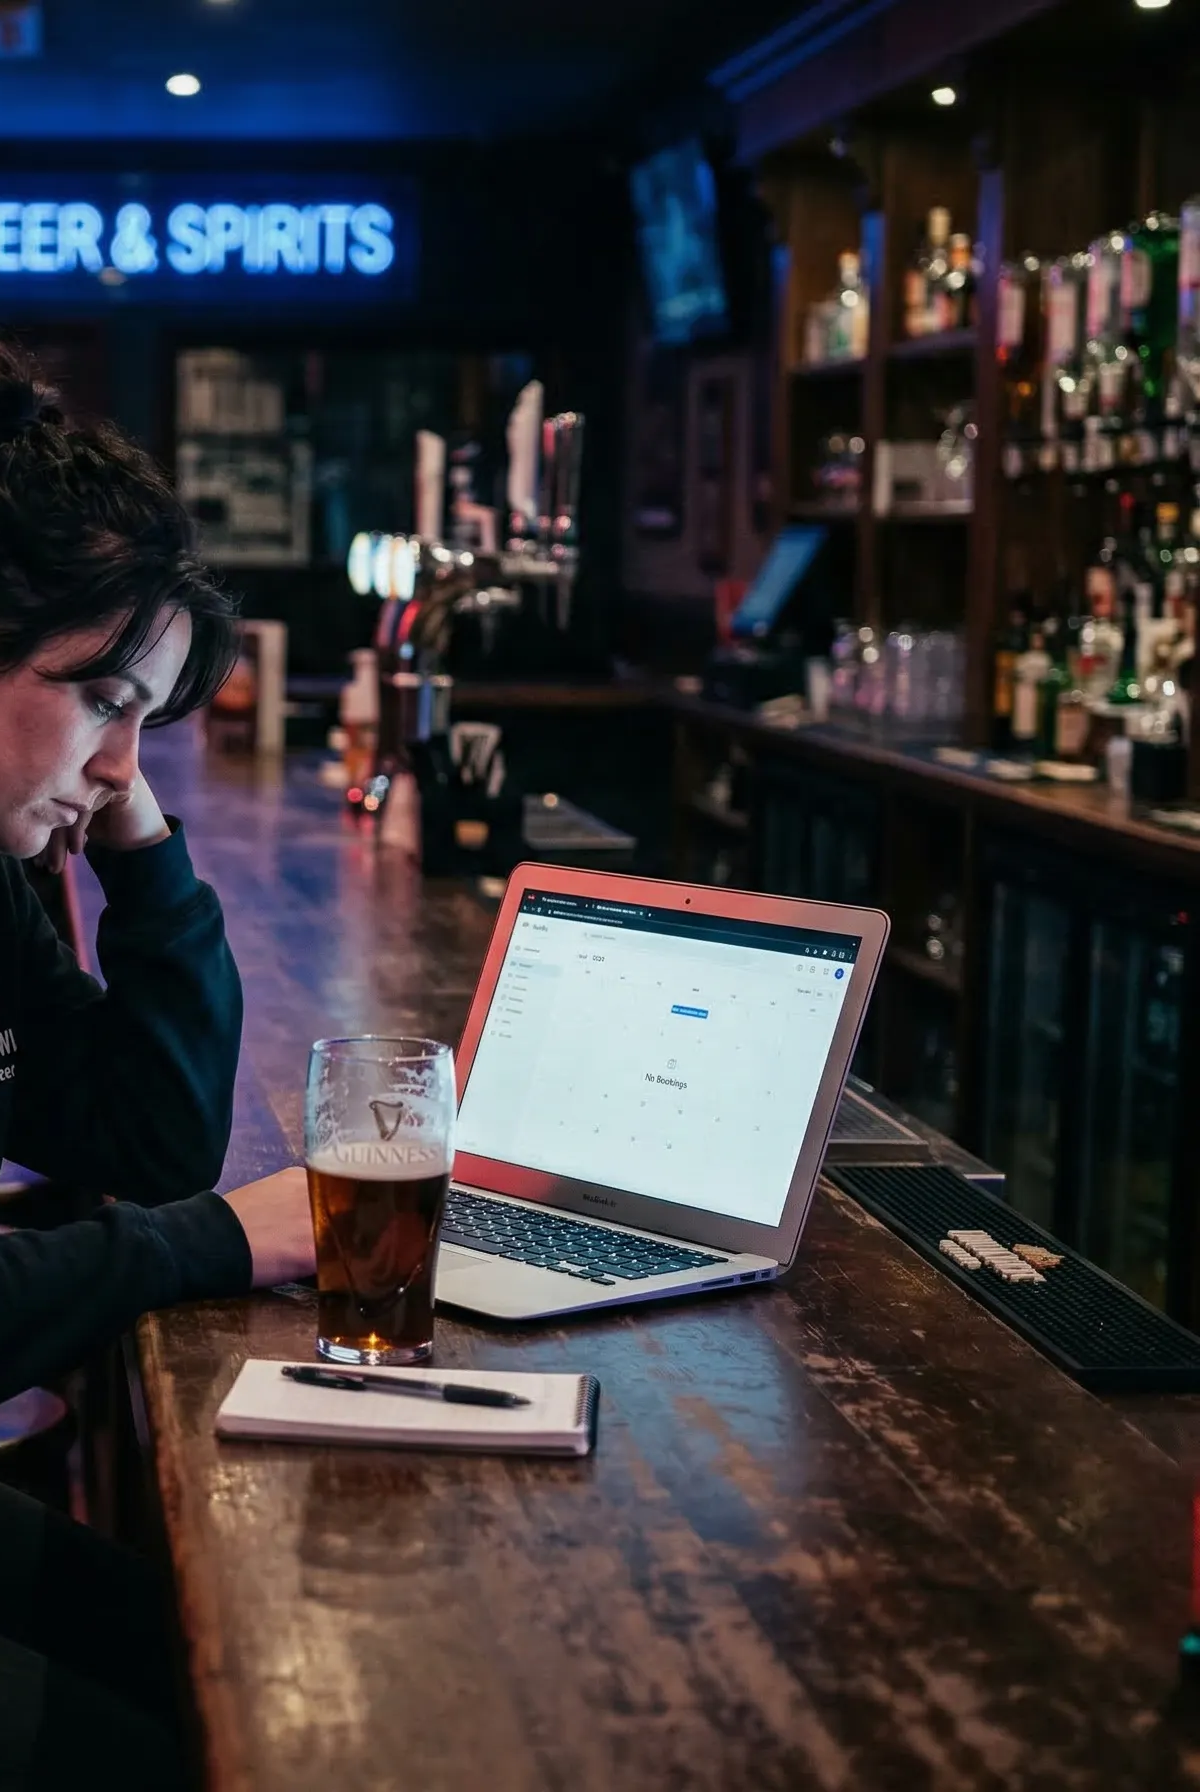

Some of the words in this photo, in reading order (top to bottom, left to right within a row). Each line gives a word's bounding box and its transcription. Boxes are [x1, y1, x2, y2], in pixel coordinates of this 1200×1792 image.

[110, 203, 158, 273] &
[166, 203, 395, 274] SPIRITS
[645, 1073, 655, 1082] No
[334, 1146, 438, 1165] GUINNESS
